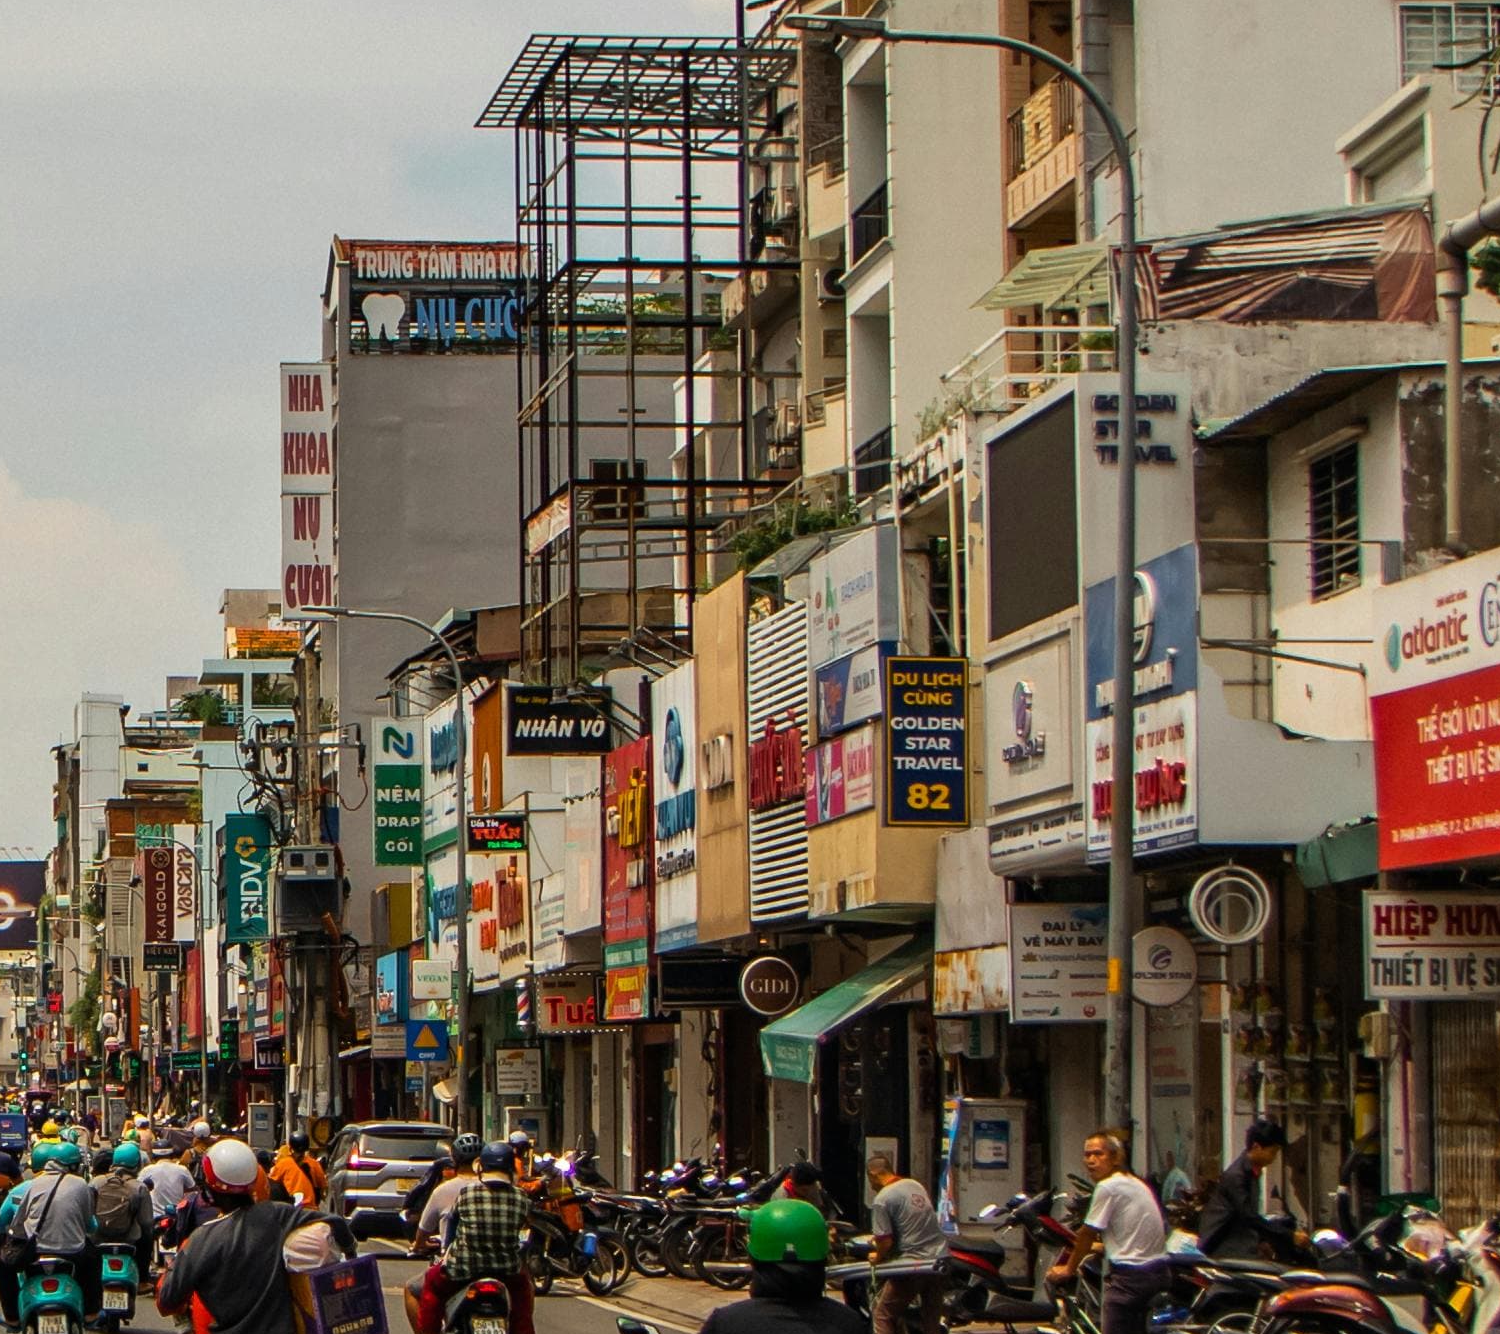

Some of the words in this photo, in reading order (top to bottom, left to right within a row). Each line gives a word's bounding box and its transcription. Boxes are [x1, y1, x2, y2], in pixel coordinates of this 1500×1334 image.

[355, 250, 414, 279] TRUNG
[418, 247, 458, 279] TÂM
[461, 251, 497, 279] NHA
[415, 297, 456, 347] NỤ
[464, 289, 526, 340] CƯỜ
[288, 374, 324, 412] NHA
[1093, 394, 1177, 412] GODEN
[1093, 419, 1152, 437] STR
[284, 432, 330, 475] KHOA
[293, 497, 321, 550] NỤ
[285, 553, 331, 608] CƯỜI
[1402, 608, 1469, 660] atlantic
[892, 673, 918, 685] DU
[903, 688, 953, 706] CÙNG
[514, 714, 575, 738] NHÂN
[890, 716, 965, 731] GOLDEN
[1416, 703, 1439, 744] THẾ
[1440, 699, 1464, 738] GIỚI
[904, 736, 951, 751] STAR
[892, 756, 963, 771] TRAVEL
[1426, 745, 1454, 785] THIẾT
[1456, 750, 1469, 786] BỊ
[1470, 740, 1486, 783] VỆ
[377, 784, 421, 804] NỆM
[906, 782, 951, 810] 82
[377, 816, 421, 827] DRAP
[384, 836, 414, 852] GỐI
[155, 870, 167, 939] KAIGOLD
[1373, 899, 1440, 943] HIỆP
[1077, 935, 1105, 946] BAY
[417, 974, 449, 983] VEGAN
[1133, 971, 1165, 980] OLDEN
[1167, 971, 1193, 980] STAR
[1371, 952, 1421, 987] THIẾT
[1426, 957, 1448, 992] BỊ
[1453, 952, 1479, 991] VỆ
[750, 978, 789, 994] GIDI
